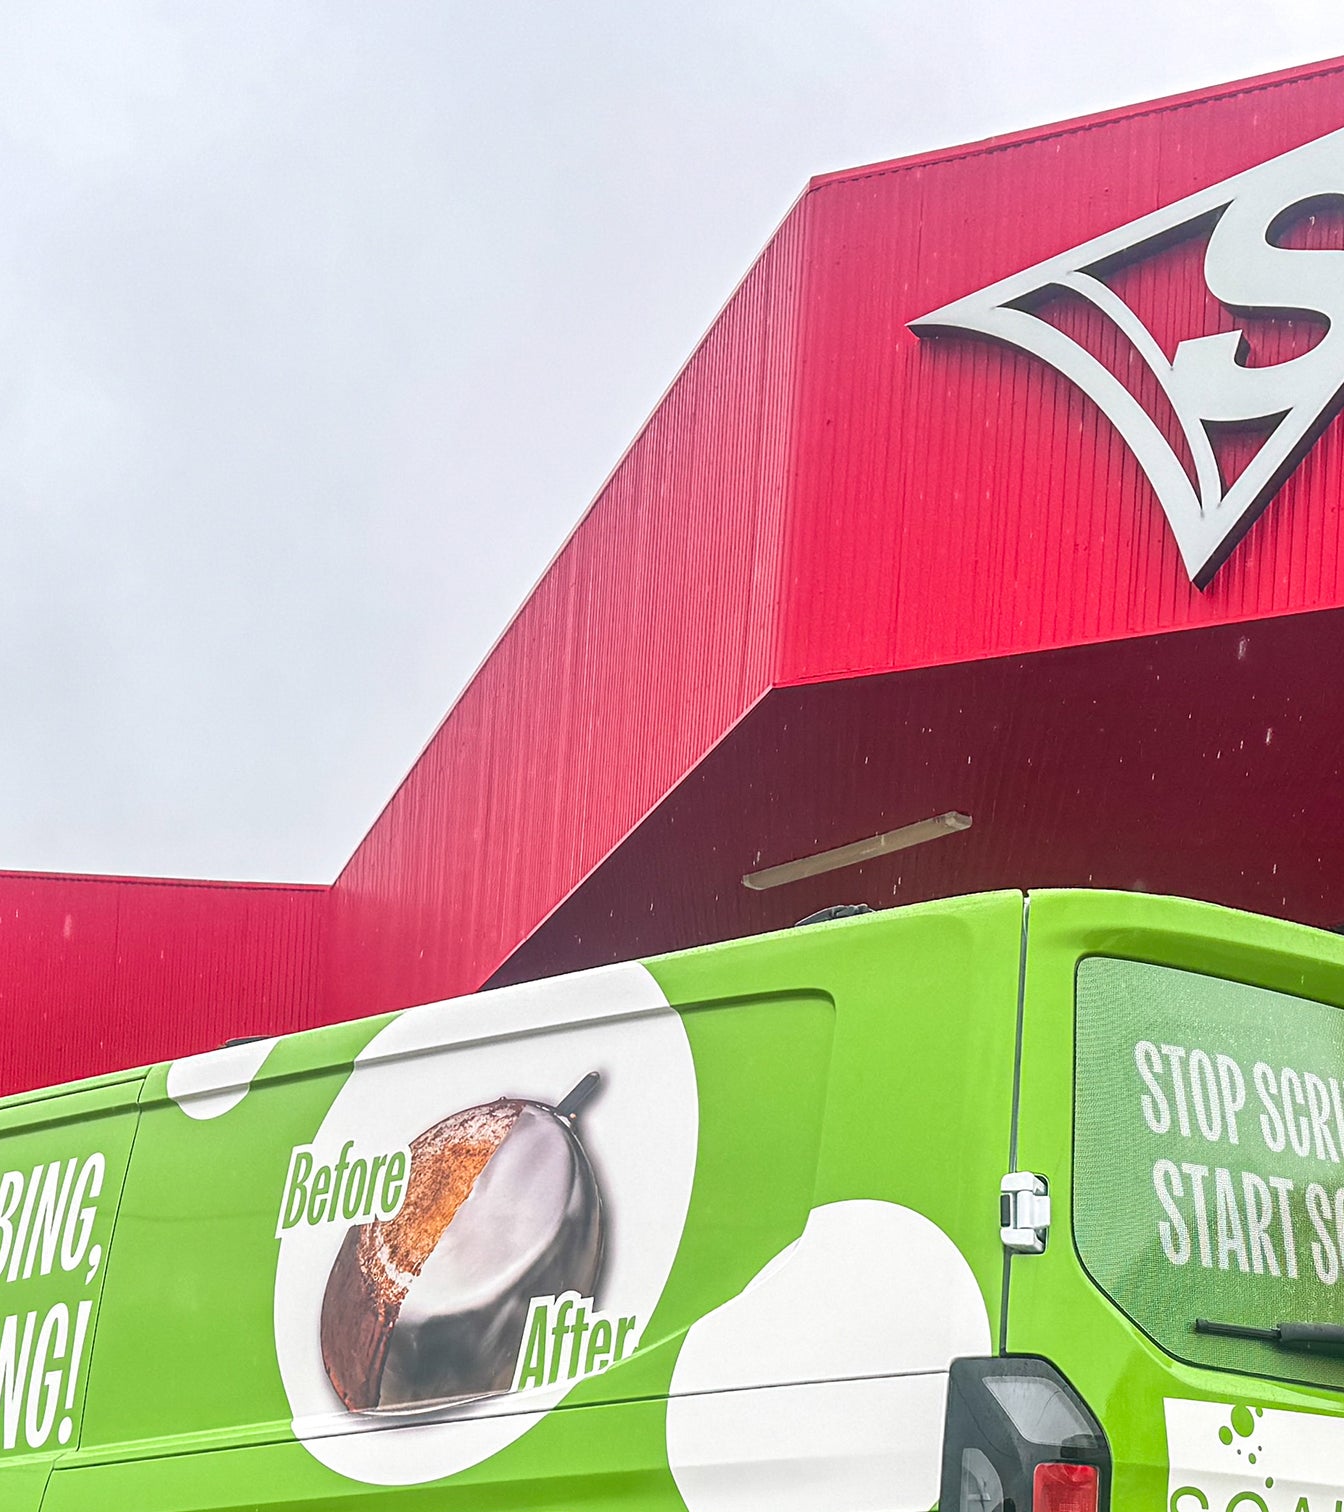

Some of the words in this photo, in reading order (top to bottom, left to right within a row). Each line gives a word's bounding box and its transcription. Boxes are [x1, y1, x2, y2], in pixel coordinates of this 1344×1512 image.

[1133, 1039, 1246, 1145] STOP
[281, 1146, 408, 1231] Before
[1151, 1158, 1299, 1279] START
[517, 1299, 638, 1392] After
